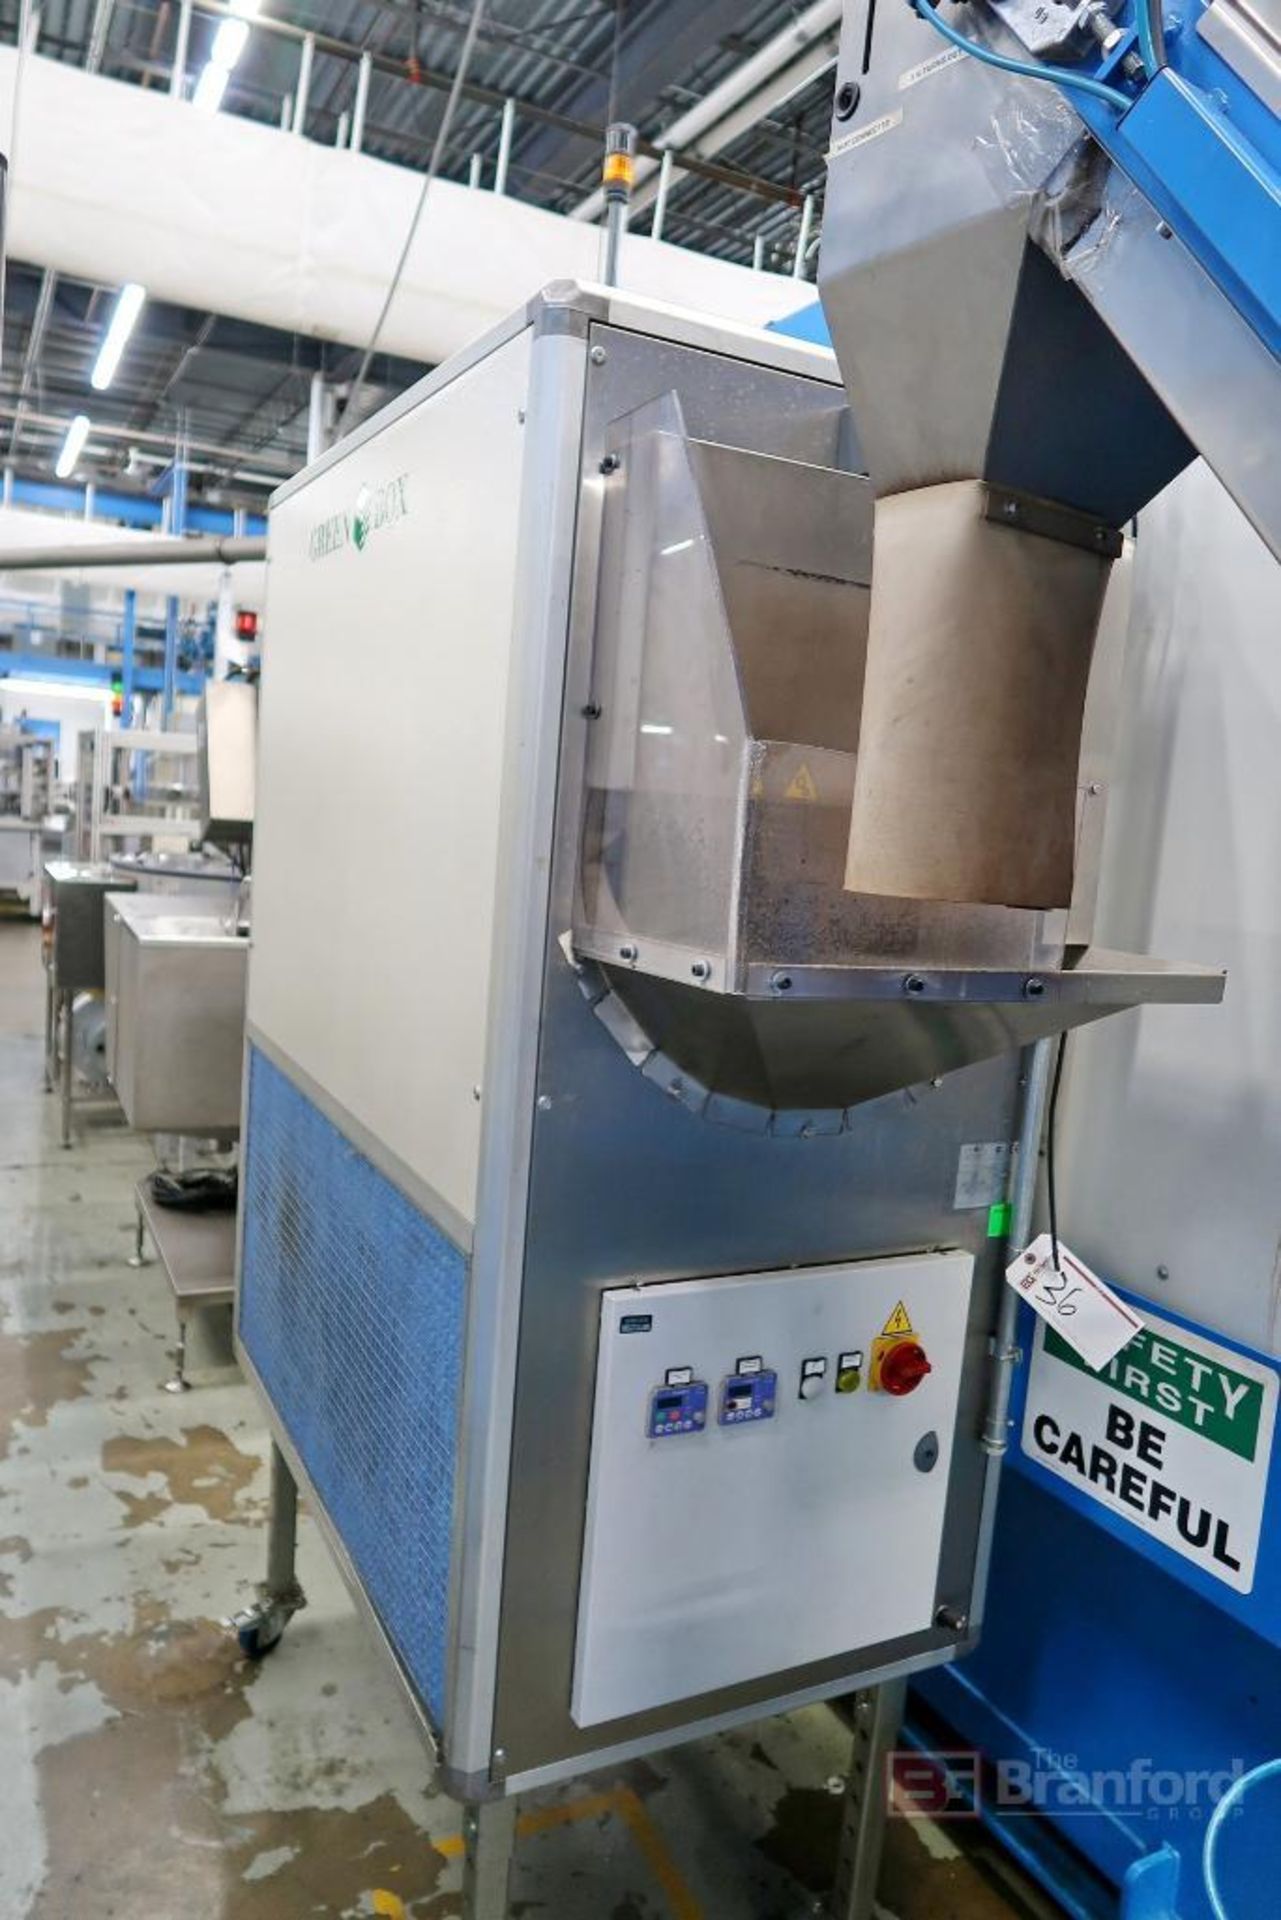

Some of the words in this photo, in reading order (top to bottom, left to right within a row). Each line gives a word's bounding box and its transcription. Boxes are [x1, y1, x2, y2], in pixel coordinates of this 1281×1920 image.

[1034, 1271, 1082, 1316] 36
[1085, 1357, 1215, 1426] IRST
[1120, 1332, 1250, 1421] FETY
[1106, 1403, 1167, 1471] BE
[1033, 1414, 1241, 1573] CAREFUL
